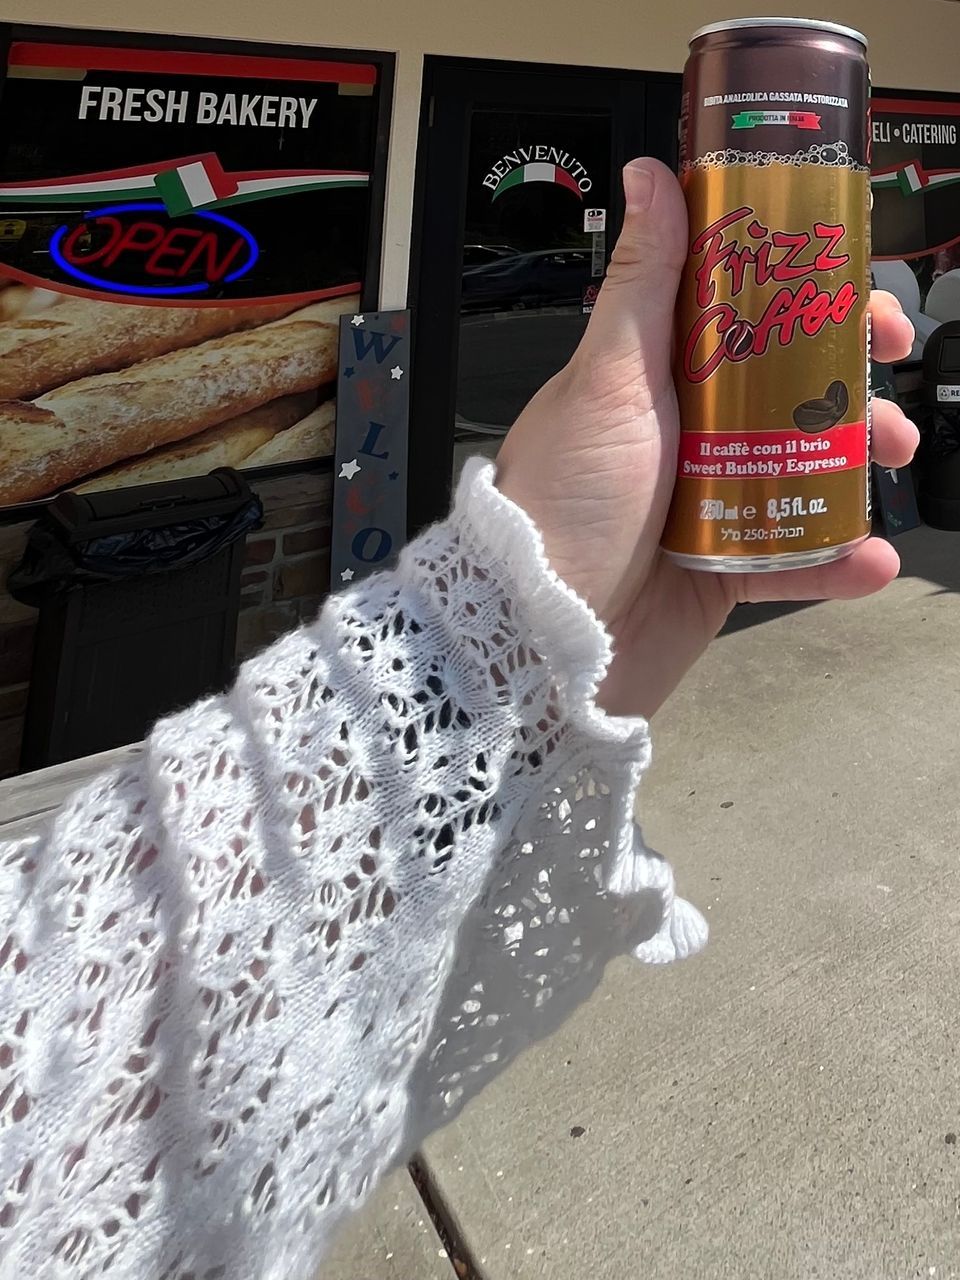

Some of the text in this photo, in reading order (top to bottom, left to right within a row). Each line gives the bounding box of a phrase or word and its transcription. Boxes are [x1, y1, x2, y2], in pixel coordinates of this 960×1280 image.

[79, 86, 317, 129] FRESH BAKERY
[769, 92, 803, 103] GASSATA
[872, 122, 957, 145] ELI CATERING
[482, 145, 593, 193] BENVENUTO
[61, 217, 246, 283] OPEN
[692, 206, 850, 309] Frizz
[683, 278, 859, 384] Coffee
[683, 456, 847, 476] Sweet Bubbly Espresso
[700, 438, 831, 457] Il caffè con il brio
